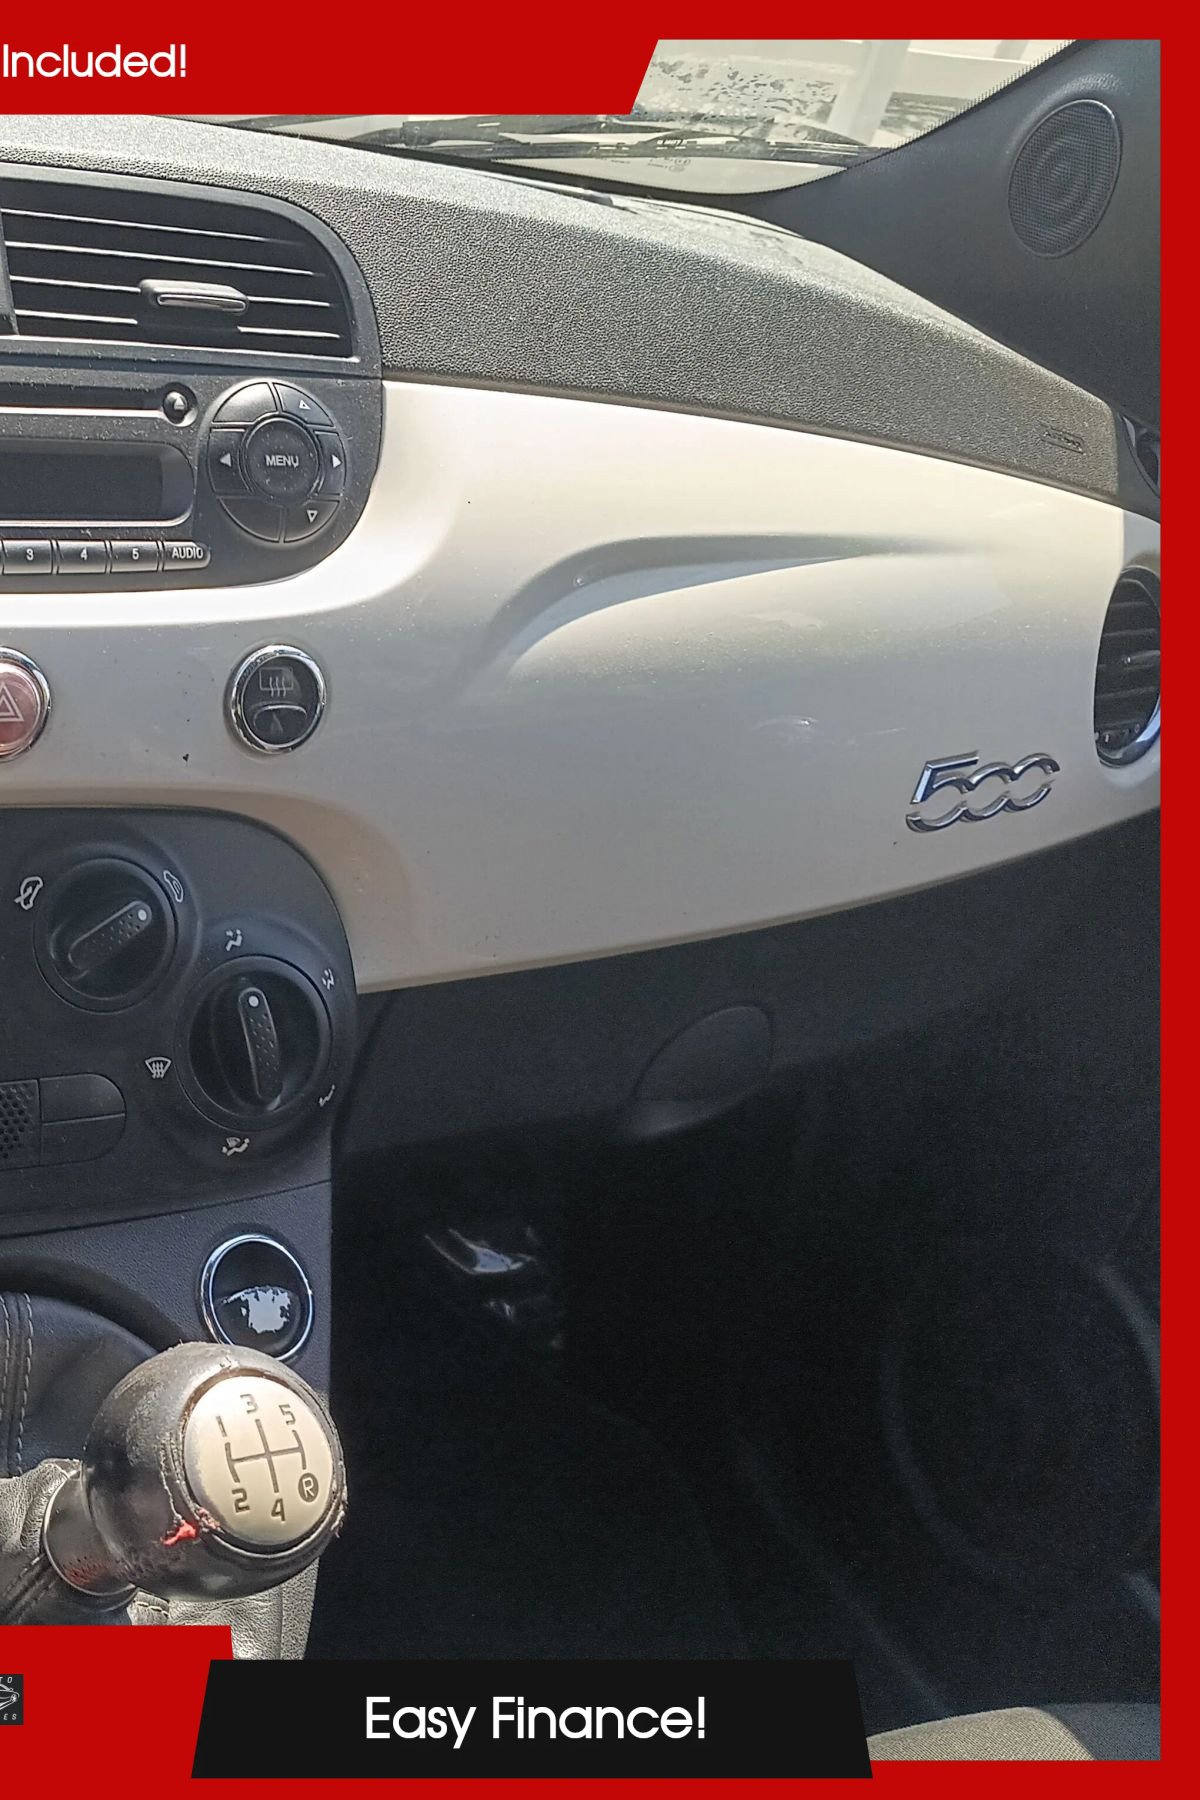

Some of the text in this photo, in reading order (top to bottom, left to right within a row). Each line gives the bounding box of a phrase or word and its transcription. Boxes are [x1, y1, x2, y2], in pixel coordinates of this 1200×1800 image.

[264, 454, 300, 468] MENU
[25, 548, 35, 561] 3
[79, 547, 89, 561] 4
[131, 547, 140, 561] 5
[171, 546, 204, 560] AUDIO
[905, 750, 1061, 834] 500
[239, 1393, 259, 1414] 3
[278, 1403, 297, 1426] 5
[302, 1475, 317, 1499] R
[231, 1487, 251, 1513] 2
[270, 1497, 287, 1523] 4
